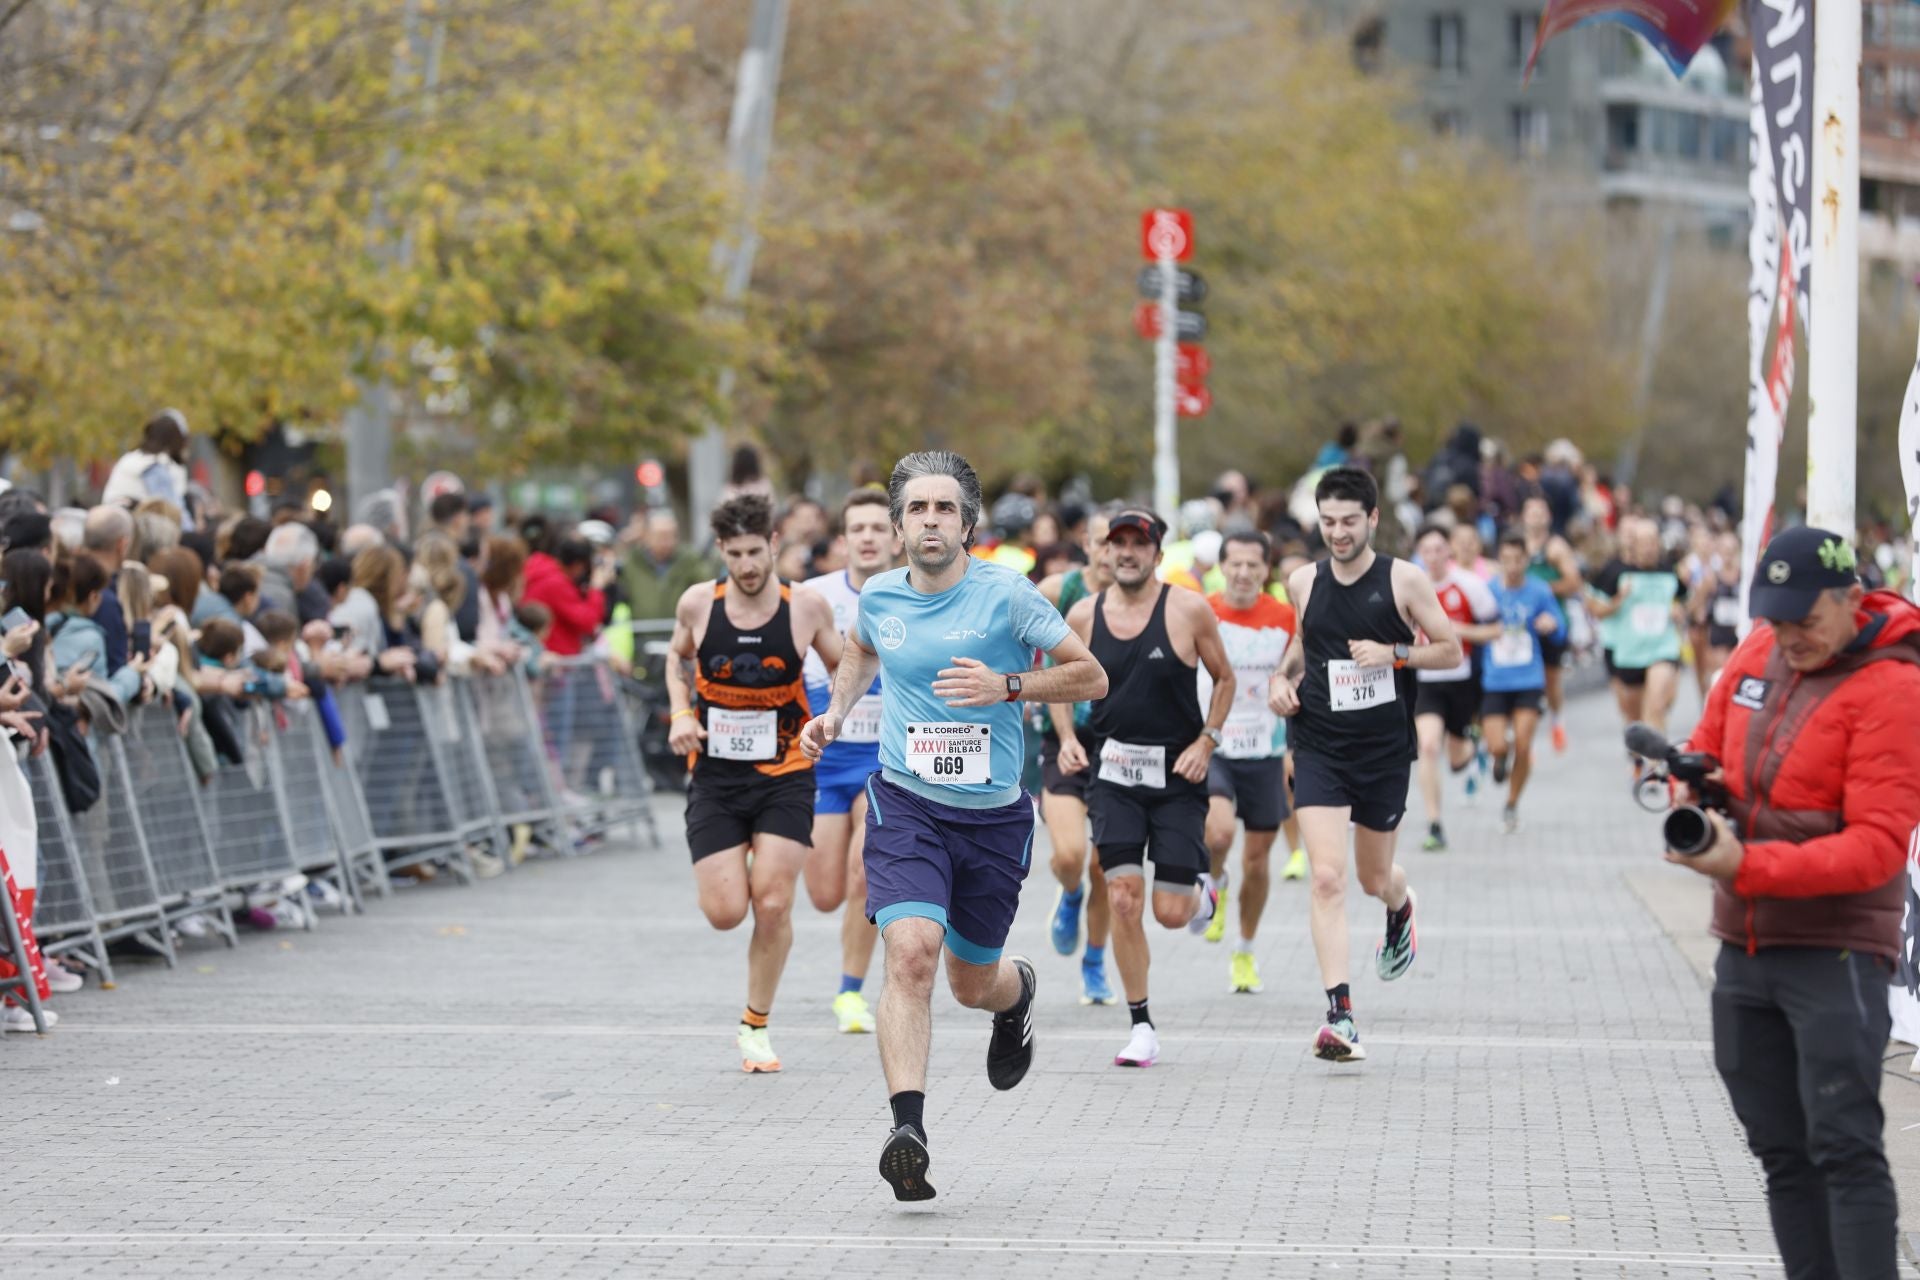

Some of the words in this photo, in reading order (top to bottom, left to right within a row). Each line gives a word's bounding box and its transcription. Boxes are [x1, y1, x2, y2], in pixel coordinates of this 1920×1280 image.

[1352, 684, 1375, 701] 376
[730, 737, 754, 752] 552
[913, 740, 946, 753] XXXVI
[948, 746, 982, 754] BILBAO
[934, 756, 964, 775] 669
